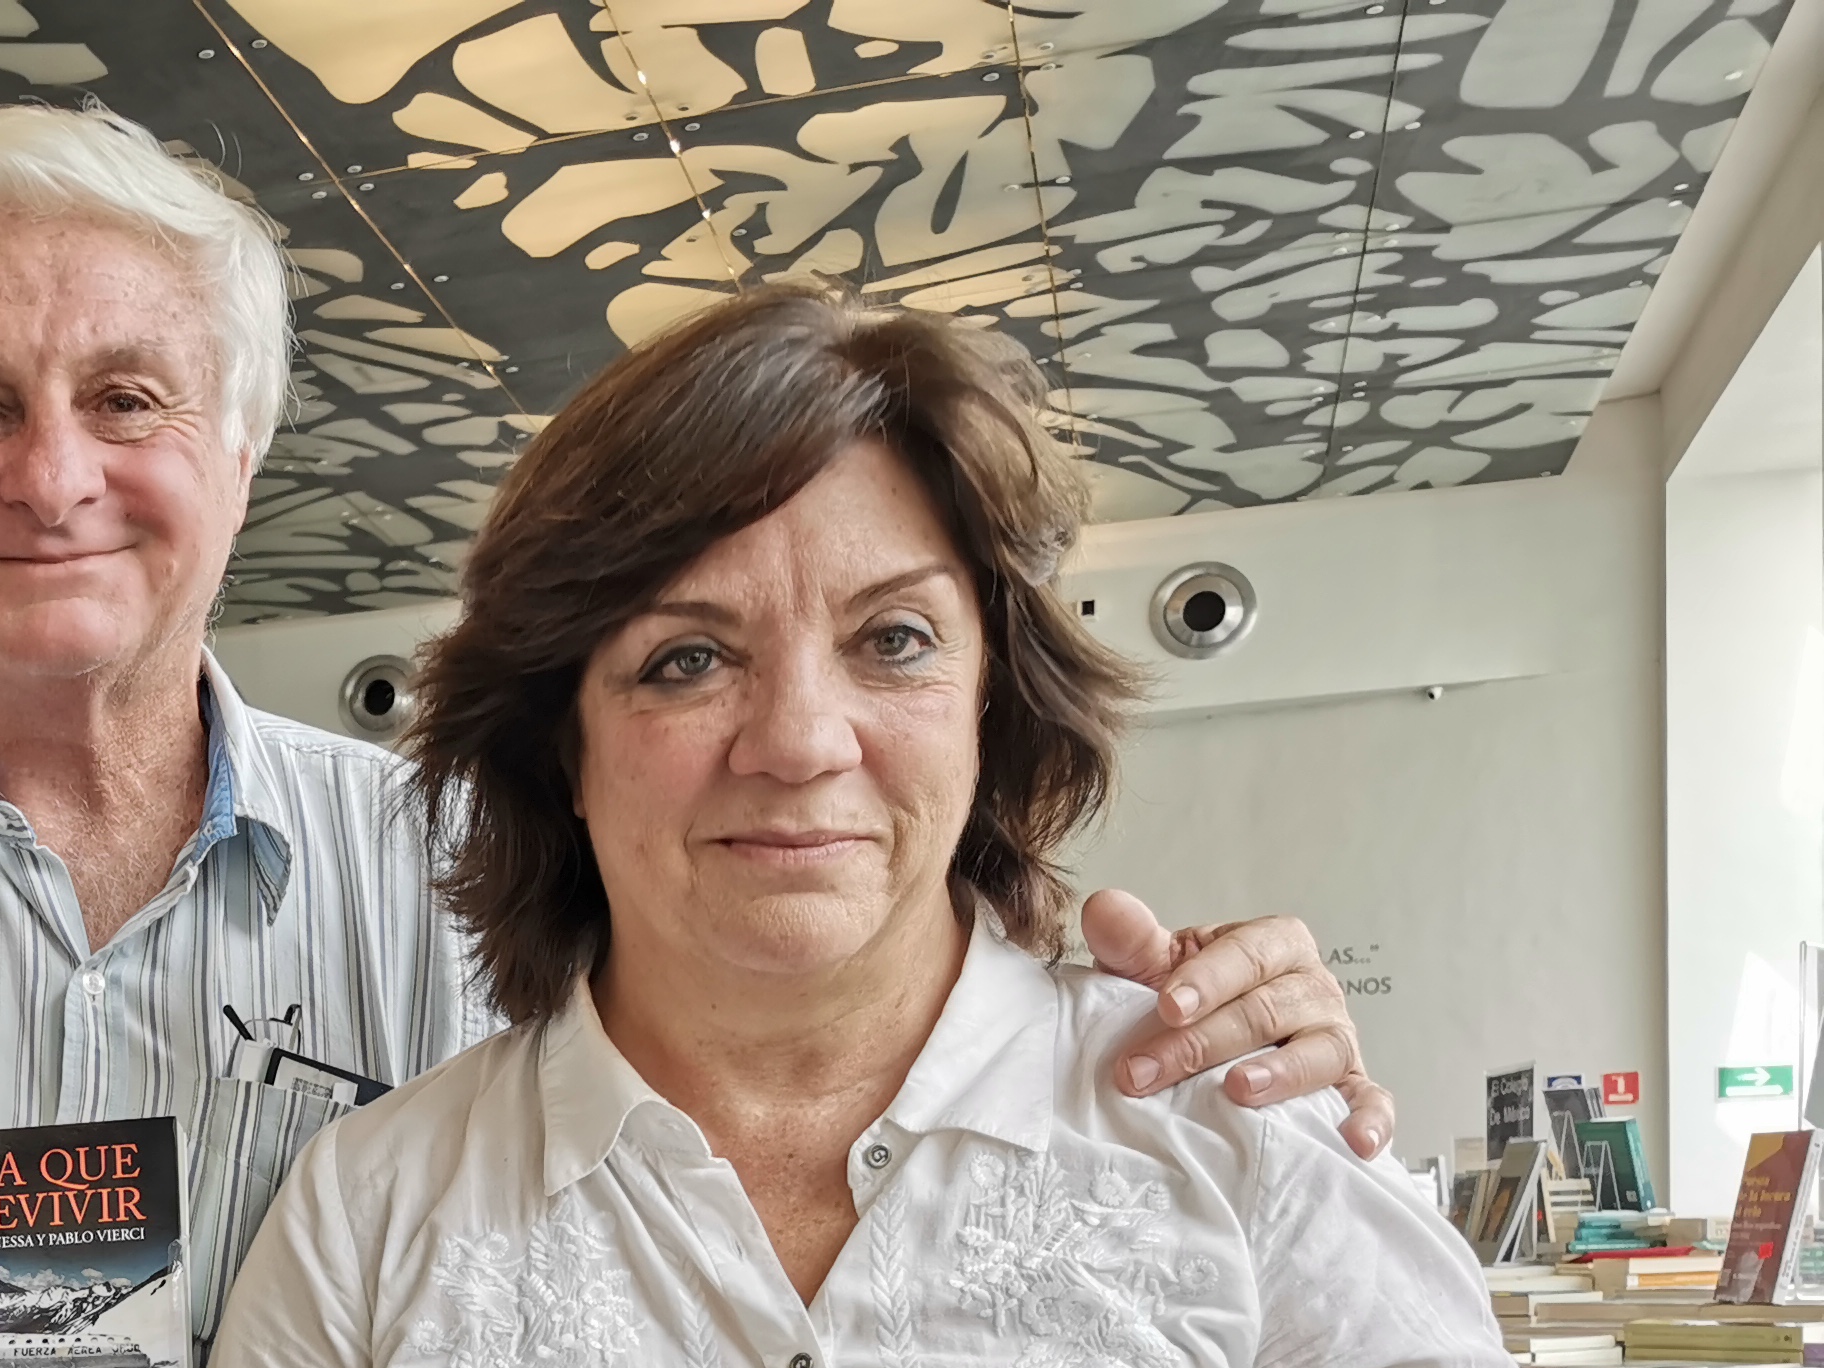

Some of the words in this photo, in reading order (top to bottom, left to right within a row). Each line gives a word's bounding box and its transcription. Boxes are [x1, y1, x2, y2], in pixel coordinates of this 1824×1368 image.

[39, 1143, 142, 1191] QUE
[36, 1233, 46, 1247] Y
[47, 1230, 94, 1246] PABLO
[95, 1227, 145, 1242] VIERCI
[13, 1346, 57, 1357] FUERZA
